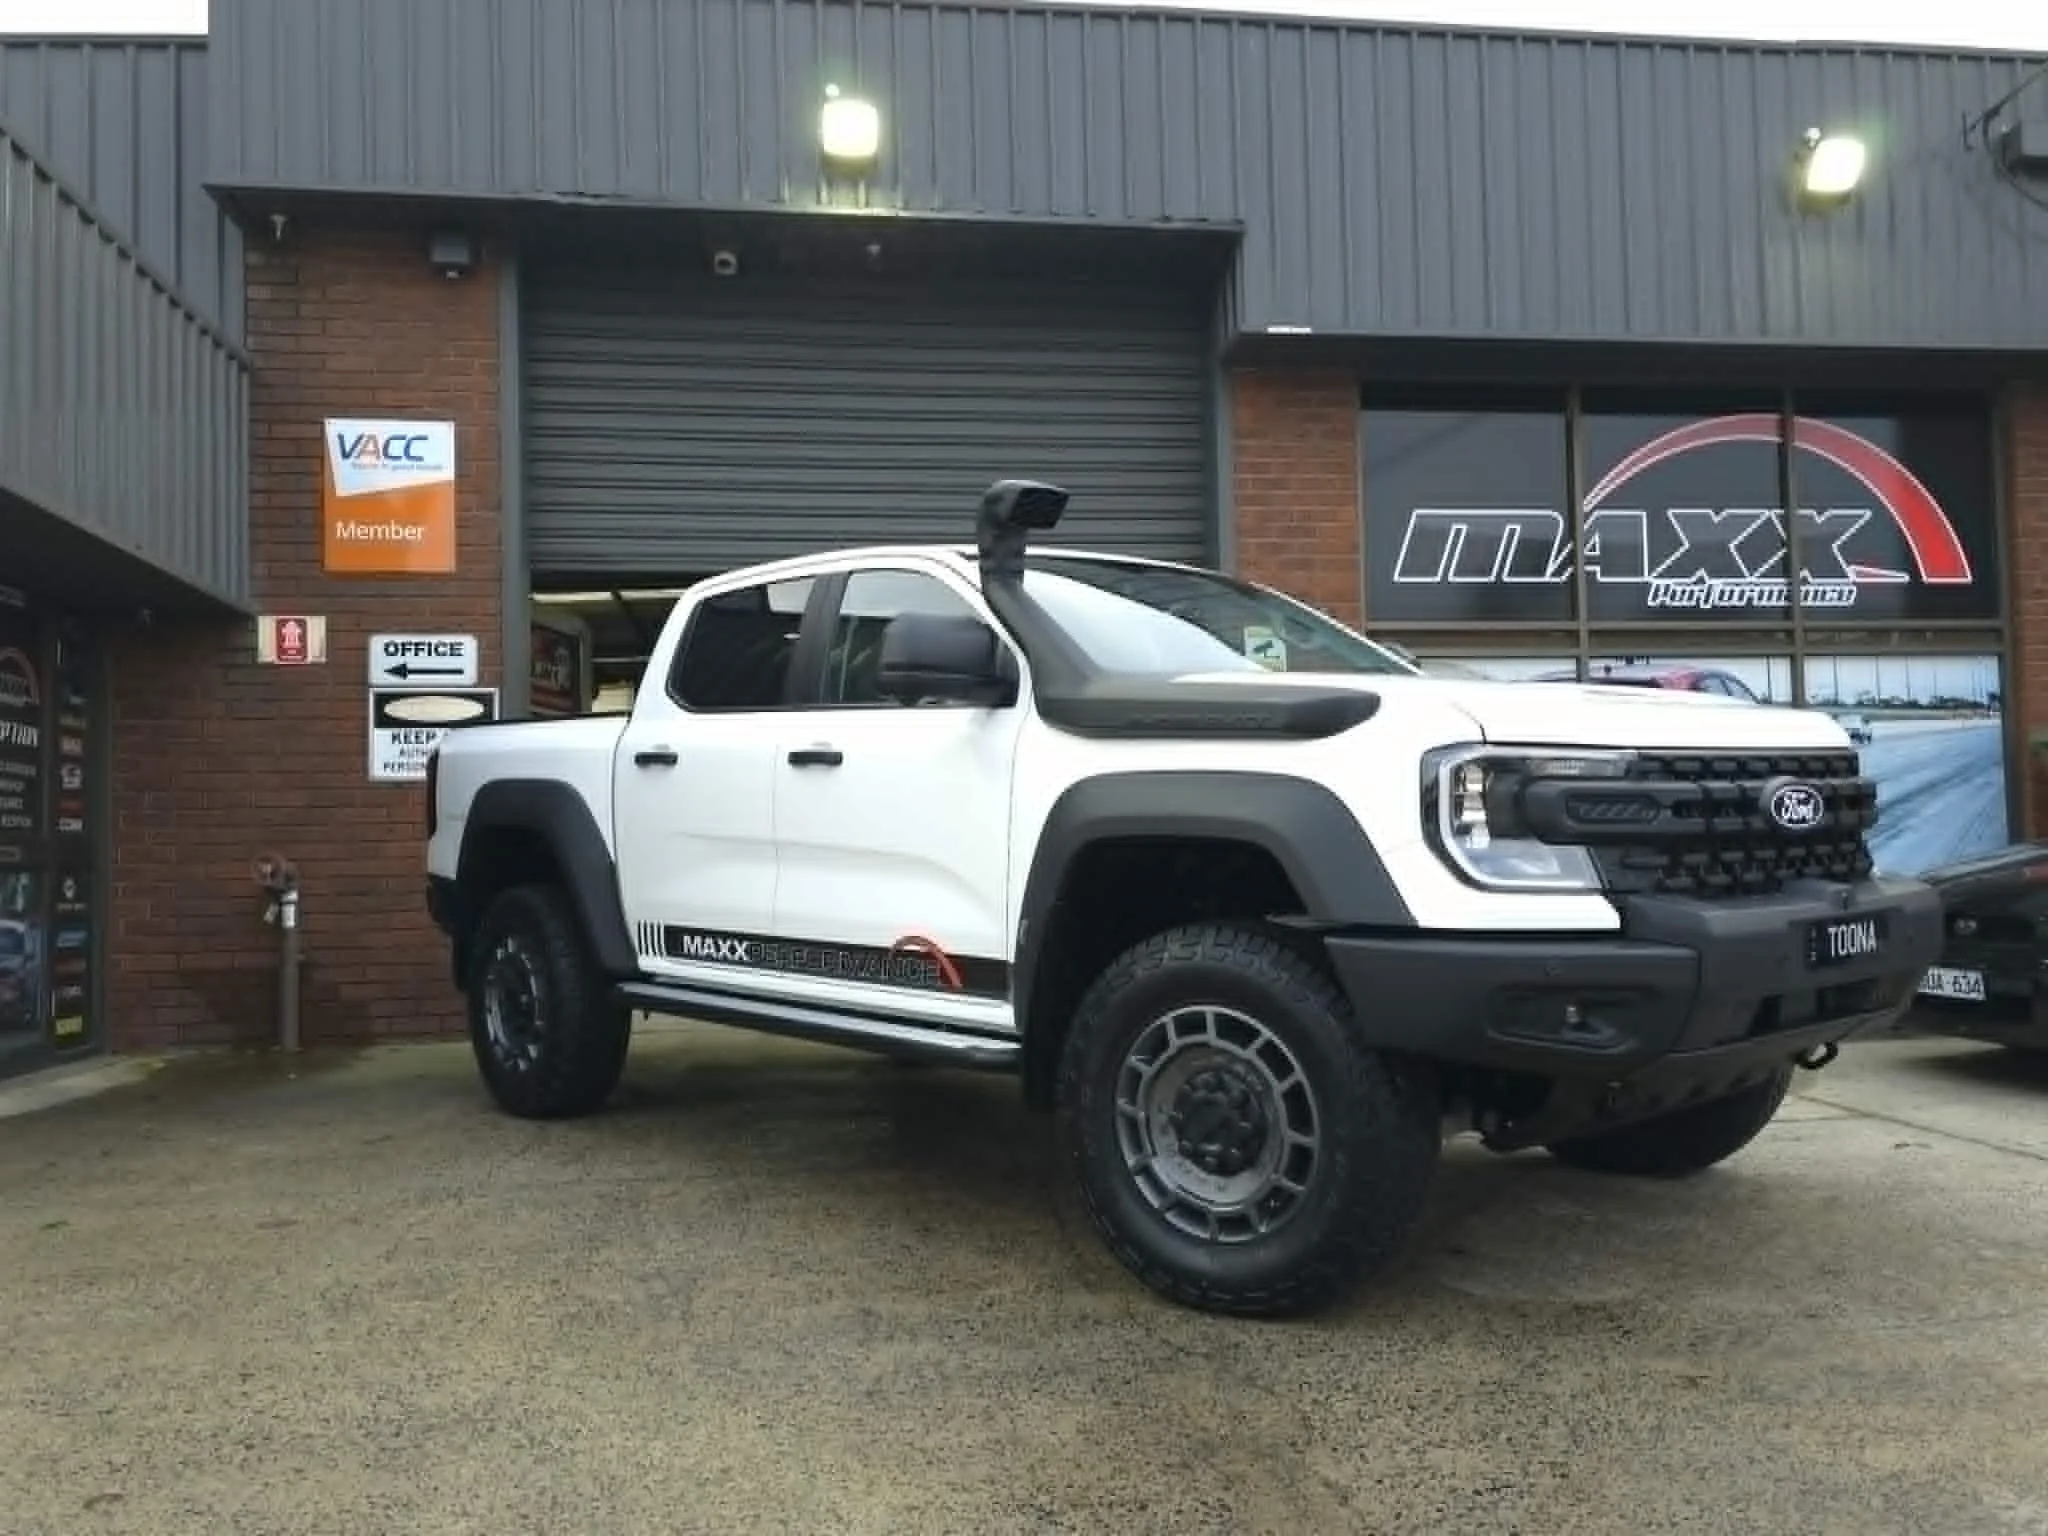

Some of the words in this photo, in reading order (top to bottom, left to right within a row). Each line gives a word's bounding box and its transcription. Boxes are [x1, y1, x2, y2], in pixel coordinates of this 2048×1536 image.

[337, 433, 429, 462] VACC
[335, 519, 425, 541] Member
[383, 640, 465, 657] OFFICE
[391, 730, 437, 745] KEEP
[682, 934, 750, 962] MAXX
[1827, 919, 1877, 958] TOONA
